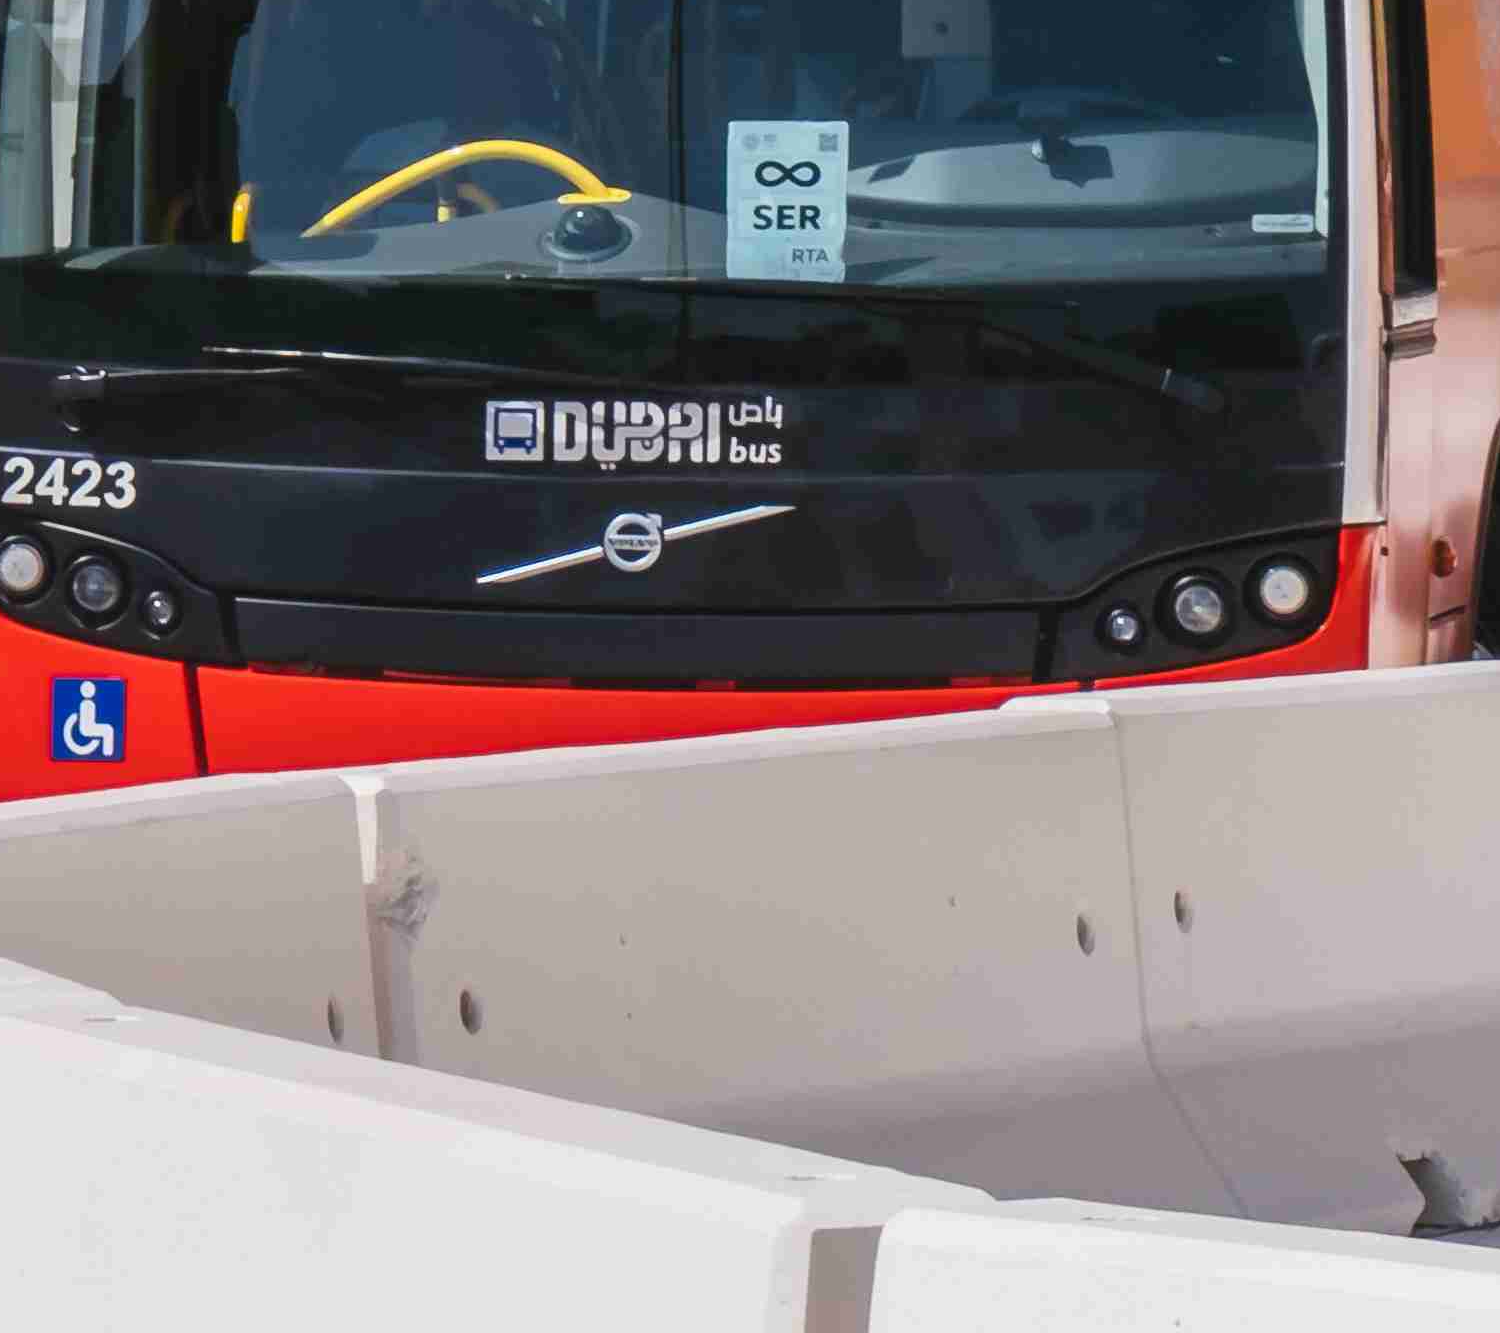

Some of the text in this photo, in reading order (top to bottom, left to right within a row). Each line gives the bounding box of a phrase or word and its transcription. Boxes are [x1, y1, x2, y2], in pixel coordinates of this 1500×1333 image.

[752, 205, 822, 231] SER
[792, 248, 830, 264] RTA
[728, 436, 782, 464] bus
[1, 456, 137, 509] 2423
